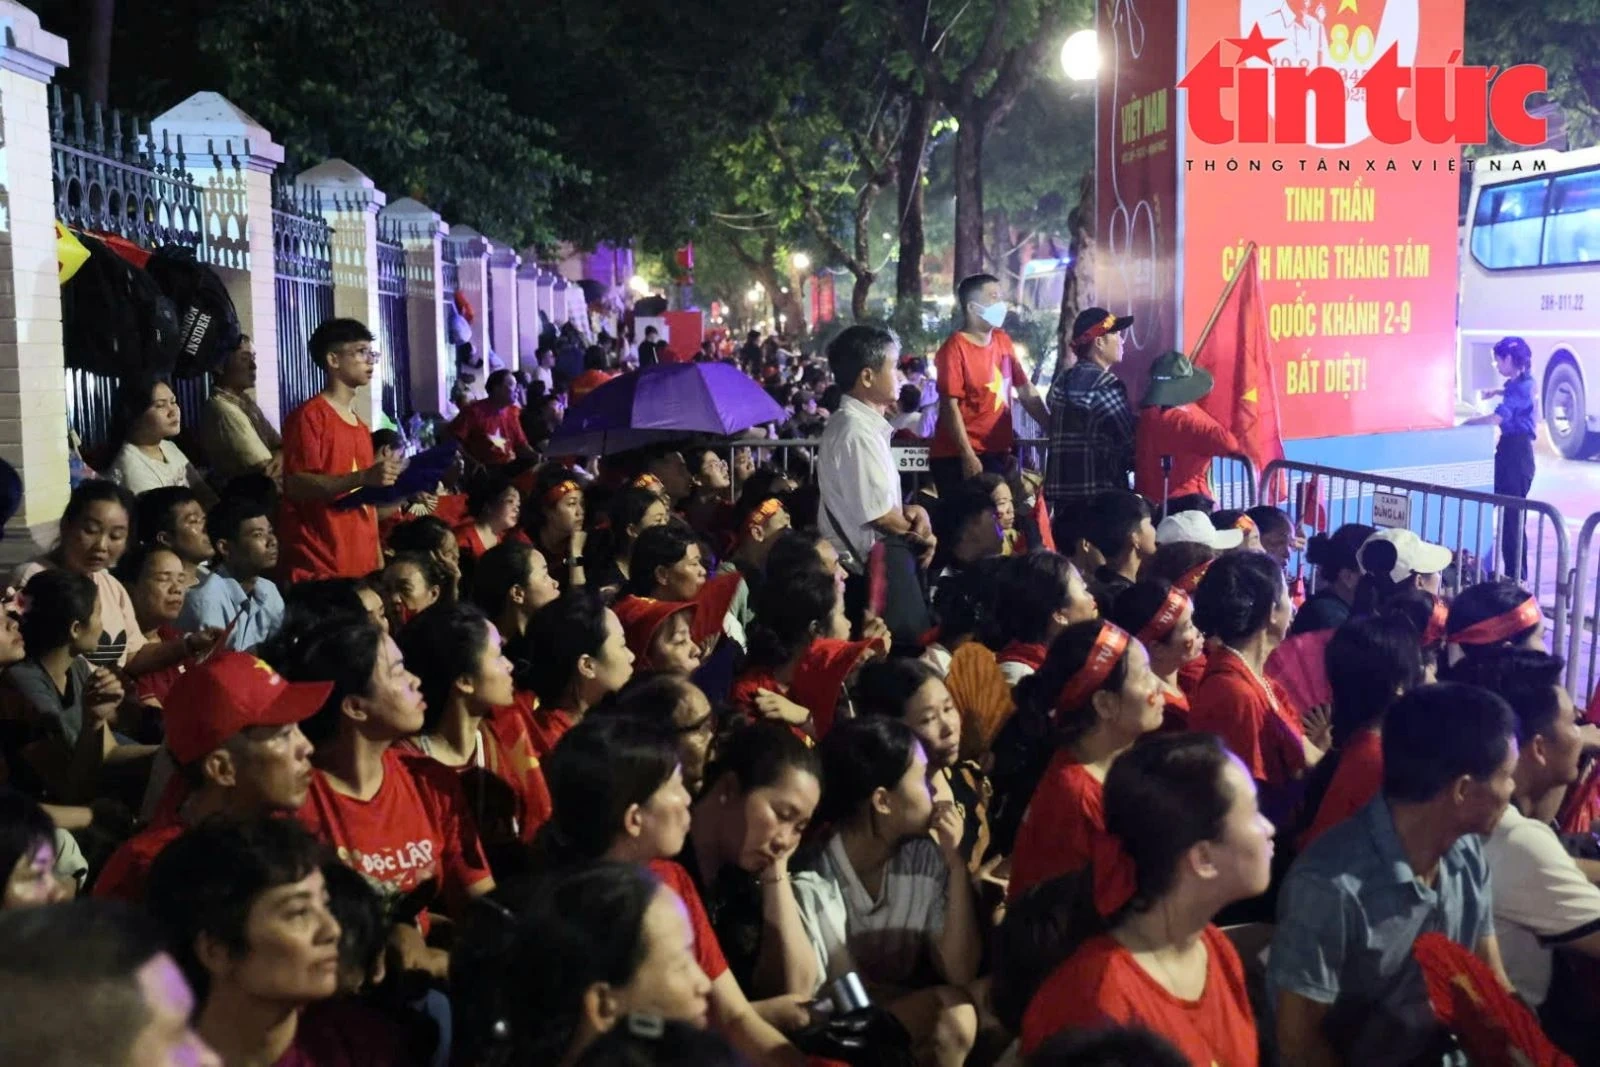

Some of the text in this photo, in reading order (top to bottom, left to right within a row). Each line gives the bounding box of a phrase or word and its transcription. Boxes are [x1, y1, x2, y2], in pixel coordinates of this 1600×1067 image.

[1329, 24, 1375, 64] 80
[1284, 175, 1375, 222] TINH THẦN
[1221, 237, 1430, 288] CÁH MẠNG THÁNG TÁM
[185, 313, 212, 356] INSIDER
[1269, 290, 1411, 342] QUỐC KHÁNH 2-9
[1286, 347, 1367, 400] BẤT DIỆT!
